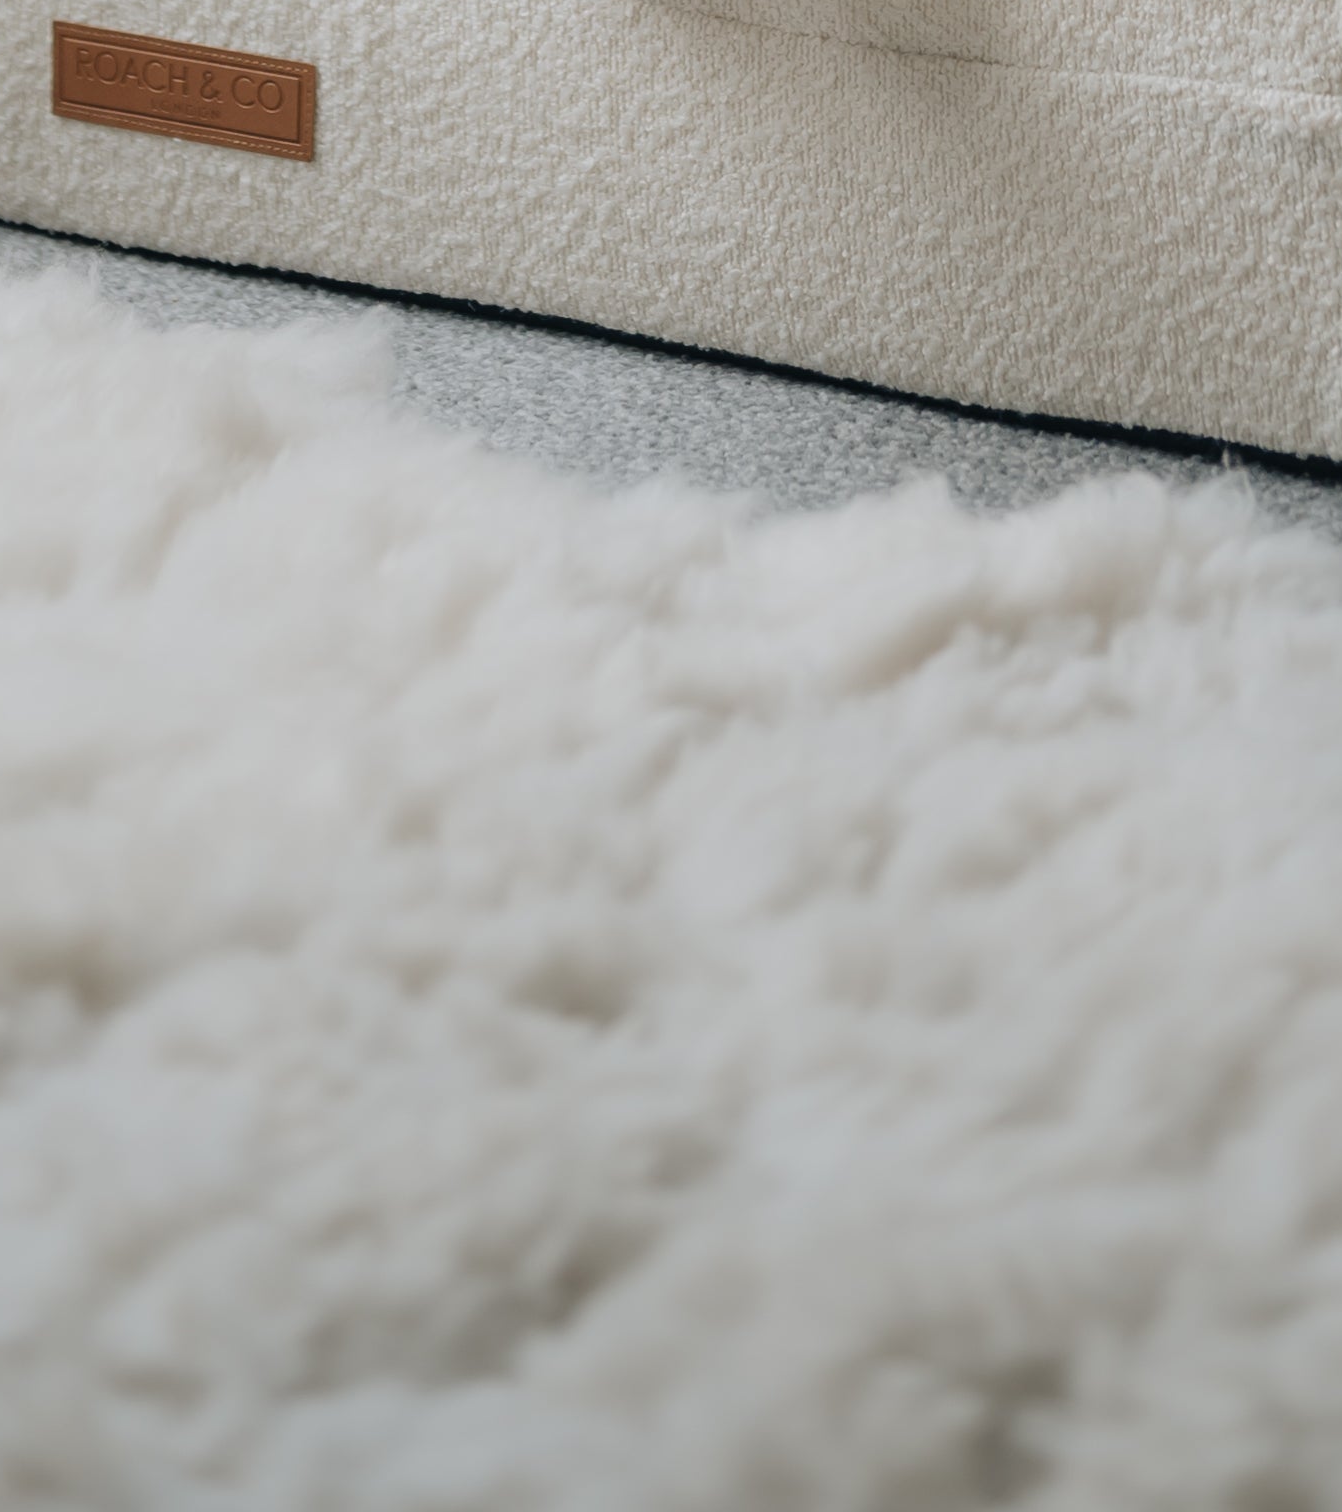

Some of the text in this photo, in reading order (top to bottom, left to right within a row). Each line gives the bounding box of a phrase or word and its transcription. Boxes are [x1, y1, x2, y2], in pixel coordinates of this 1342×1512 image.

[76, 48, 285, 114] ROACH & CO
[151, 99, 222, 121] LONDON
